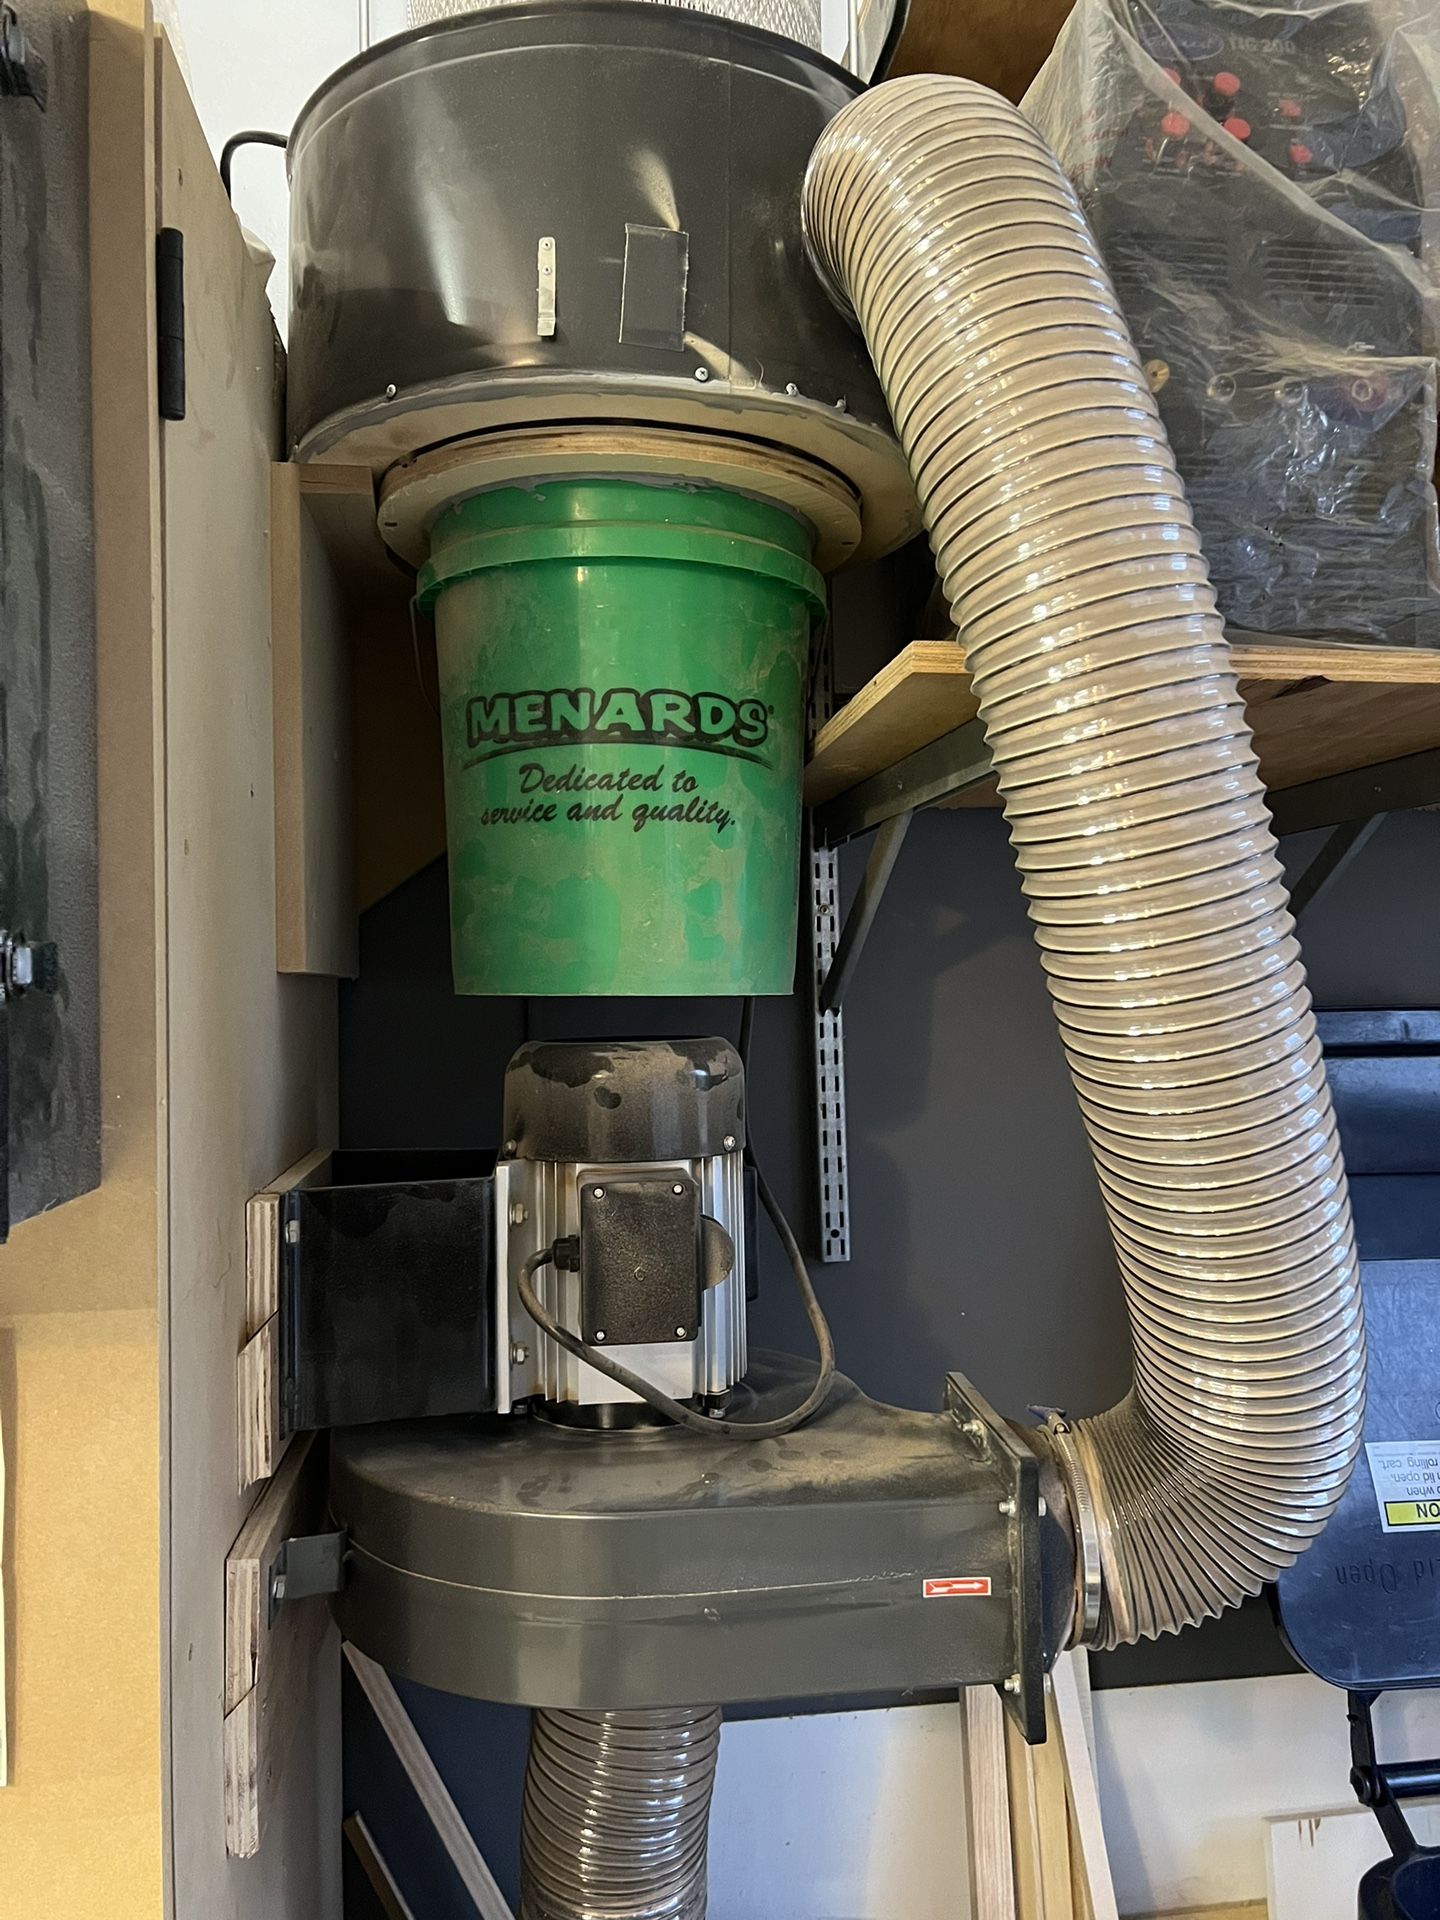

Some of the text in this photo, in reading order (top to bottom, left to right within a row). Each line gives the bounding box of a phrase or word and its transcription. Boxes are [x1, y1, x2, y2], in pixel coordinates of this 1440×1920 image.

[466, 687, 769, 749] MENARDS
[519, 762, 699, 794] Dedicated to
[481, 793, 737, 833] service and quality.
[1406, 1486, 1435, 1498] when
